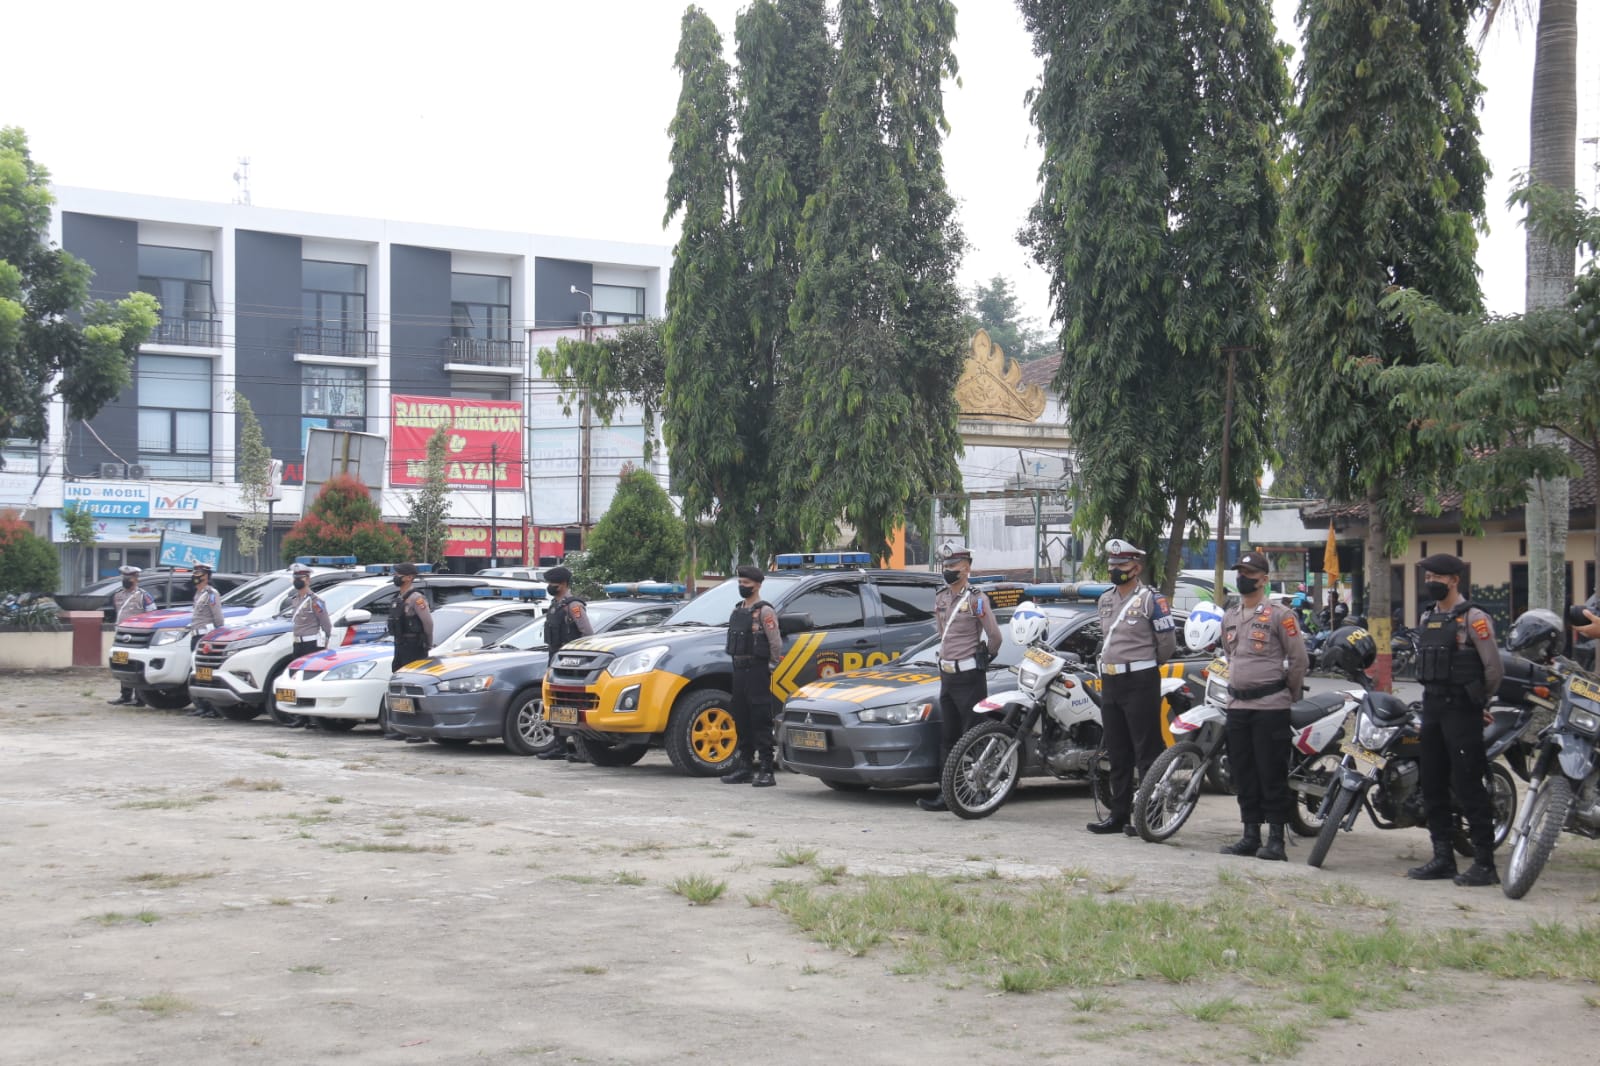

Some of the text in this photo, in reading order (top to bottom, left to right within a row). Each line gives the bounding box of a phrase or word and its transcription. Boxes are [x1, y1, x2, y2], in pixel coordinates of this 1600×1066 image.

[395, 401, 522, 432] BAKSO MERCON
[448, 461, 508, 480] AYAM
[102, 488, 145, 498] MOBIL
[75, 499, 142, 515] finance
